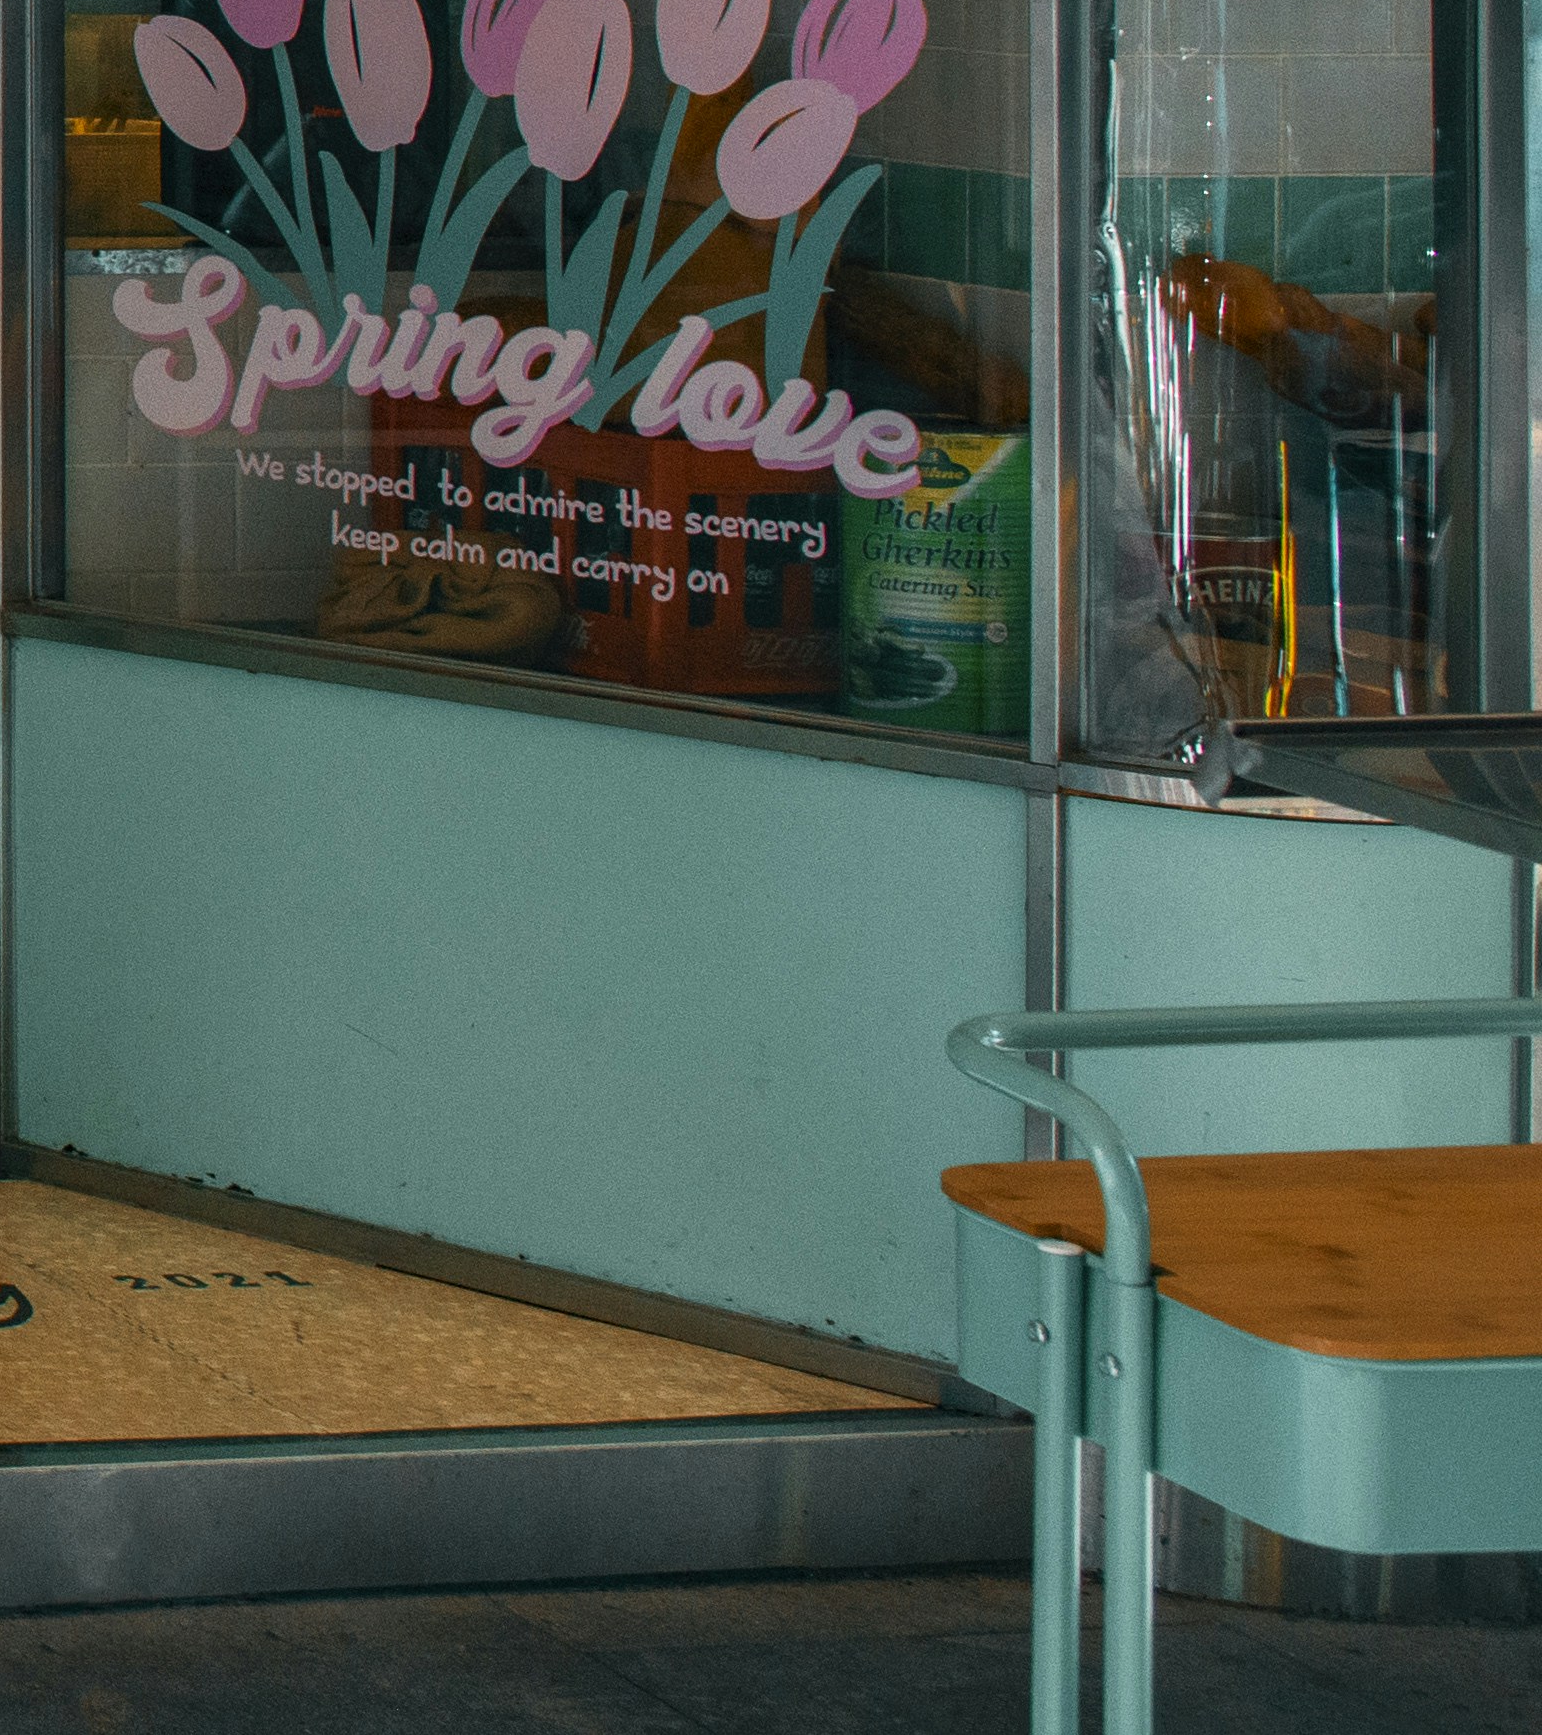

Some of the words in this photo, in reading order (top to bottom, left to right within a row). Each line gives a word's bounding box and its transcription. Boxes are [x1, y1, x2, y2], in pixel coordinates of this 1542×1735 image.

[112, 253, 596, 467] Spring
[629, 315, 923, 499] love
[235, 448, 284, 484] We
[295, 450, 416, 508] stopped
[437, 466, 473, 510] to
[484, 471, 606, 527] admire
[614, 486, 673, 535] the
[684, 508, 828, 559] scenery
[873, 499, 1000, 535] Pickled
[331, 510, 400, 565] keep
[408, 521, 487, 568] calm
[496, 533, 562, 577] and
[571, 551, 676, 602] carry
[687, 561, 730, 597] on
[861, 532, 1012, 570] Gherkins
[868, 572, 959, 601] Catering
[112, 1270, 316, 1291] 2021
